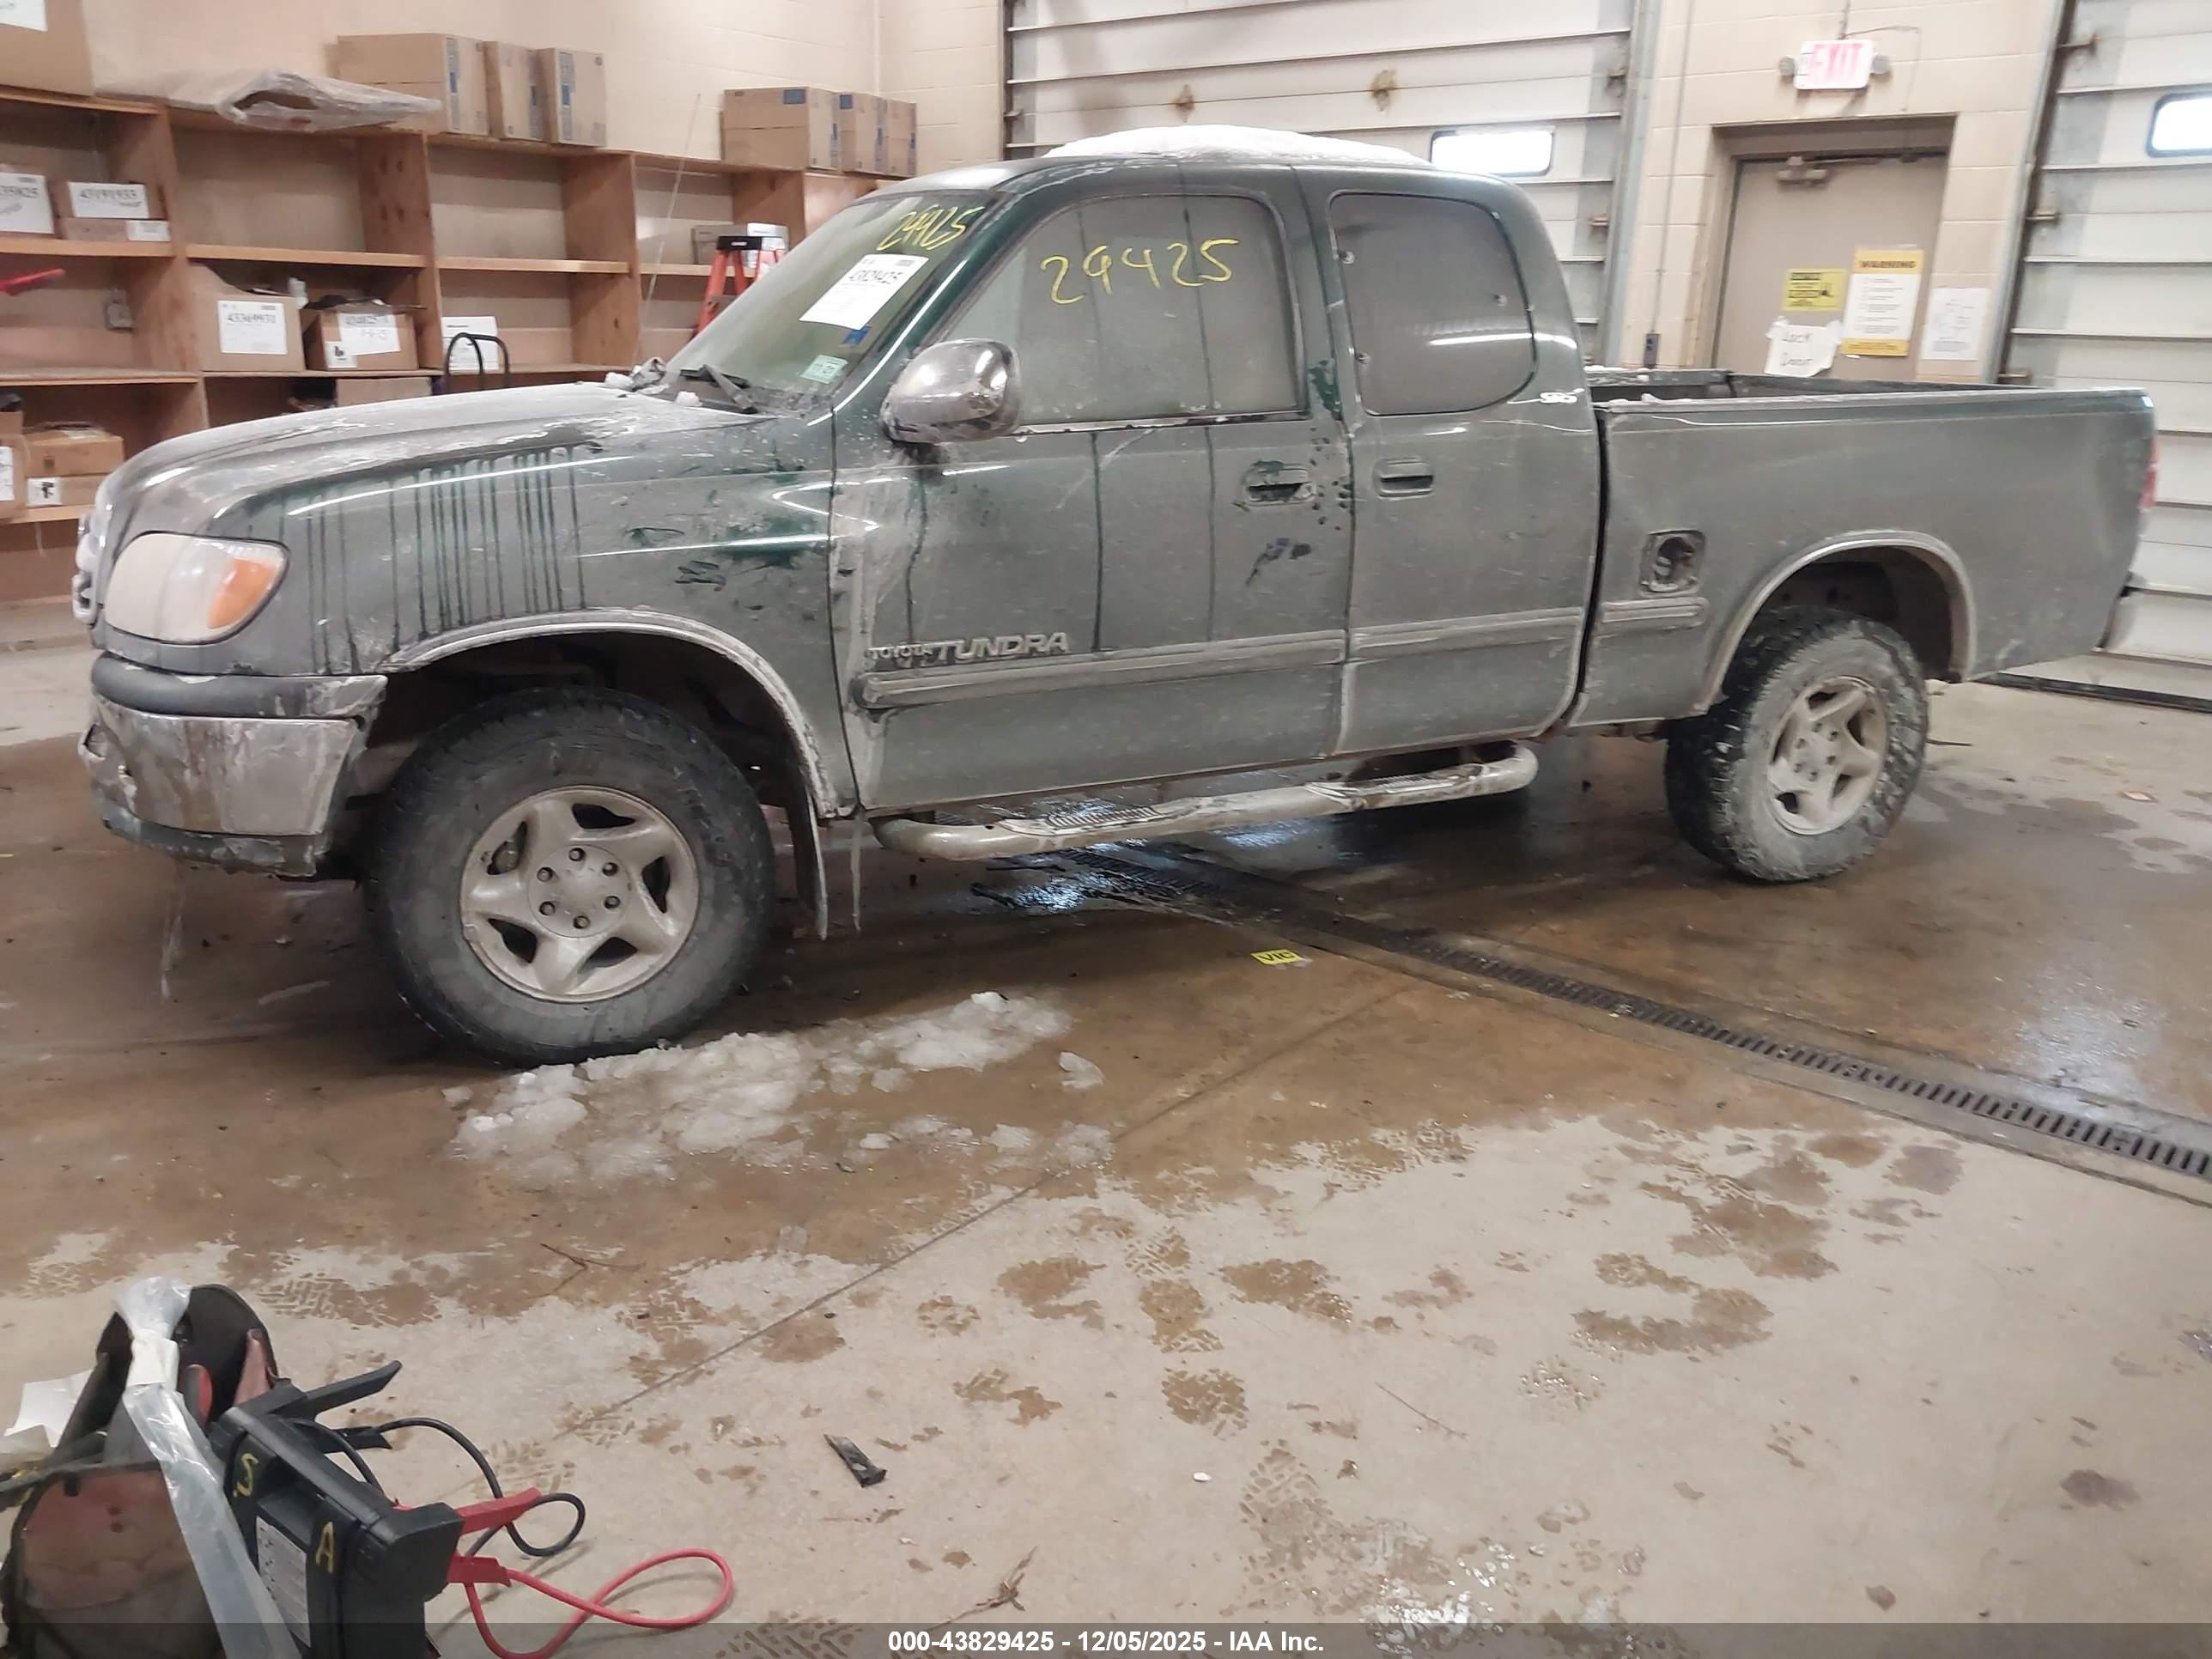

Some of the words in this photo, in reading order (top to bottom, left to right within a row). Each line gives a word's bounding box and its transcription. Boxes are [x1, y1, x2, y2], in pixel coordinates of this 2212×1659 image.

[1807, 43, 1863, 82] EXIT
[1040, 238, 1239, 304] 29425
[926, 631, 1070, 661] TUNDRA
[315, 1521, 335, 1574] A
